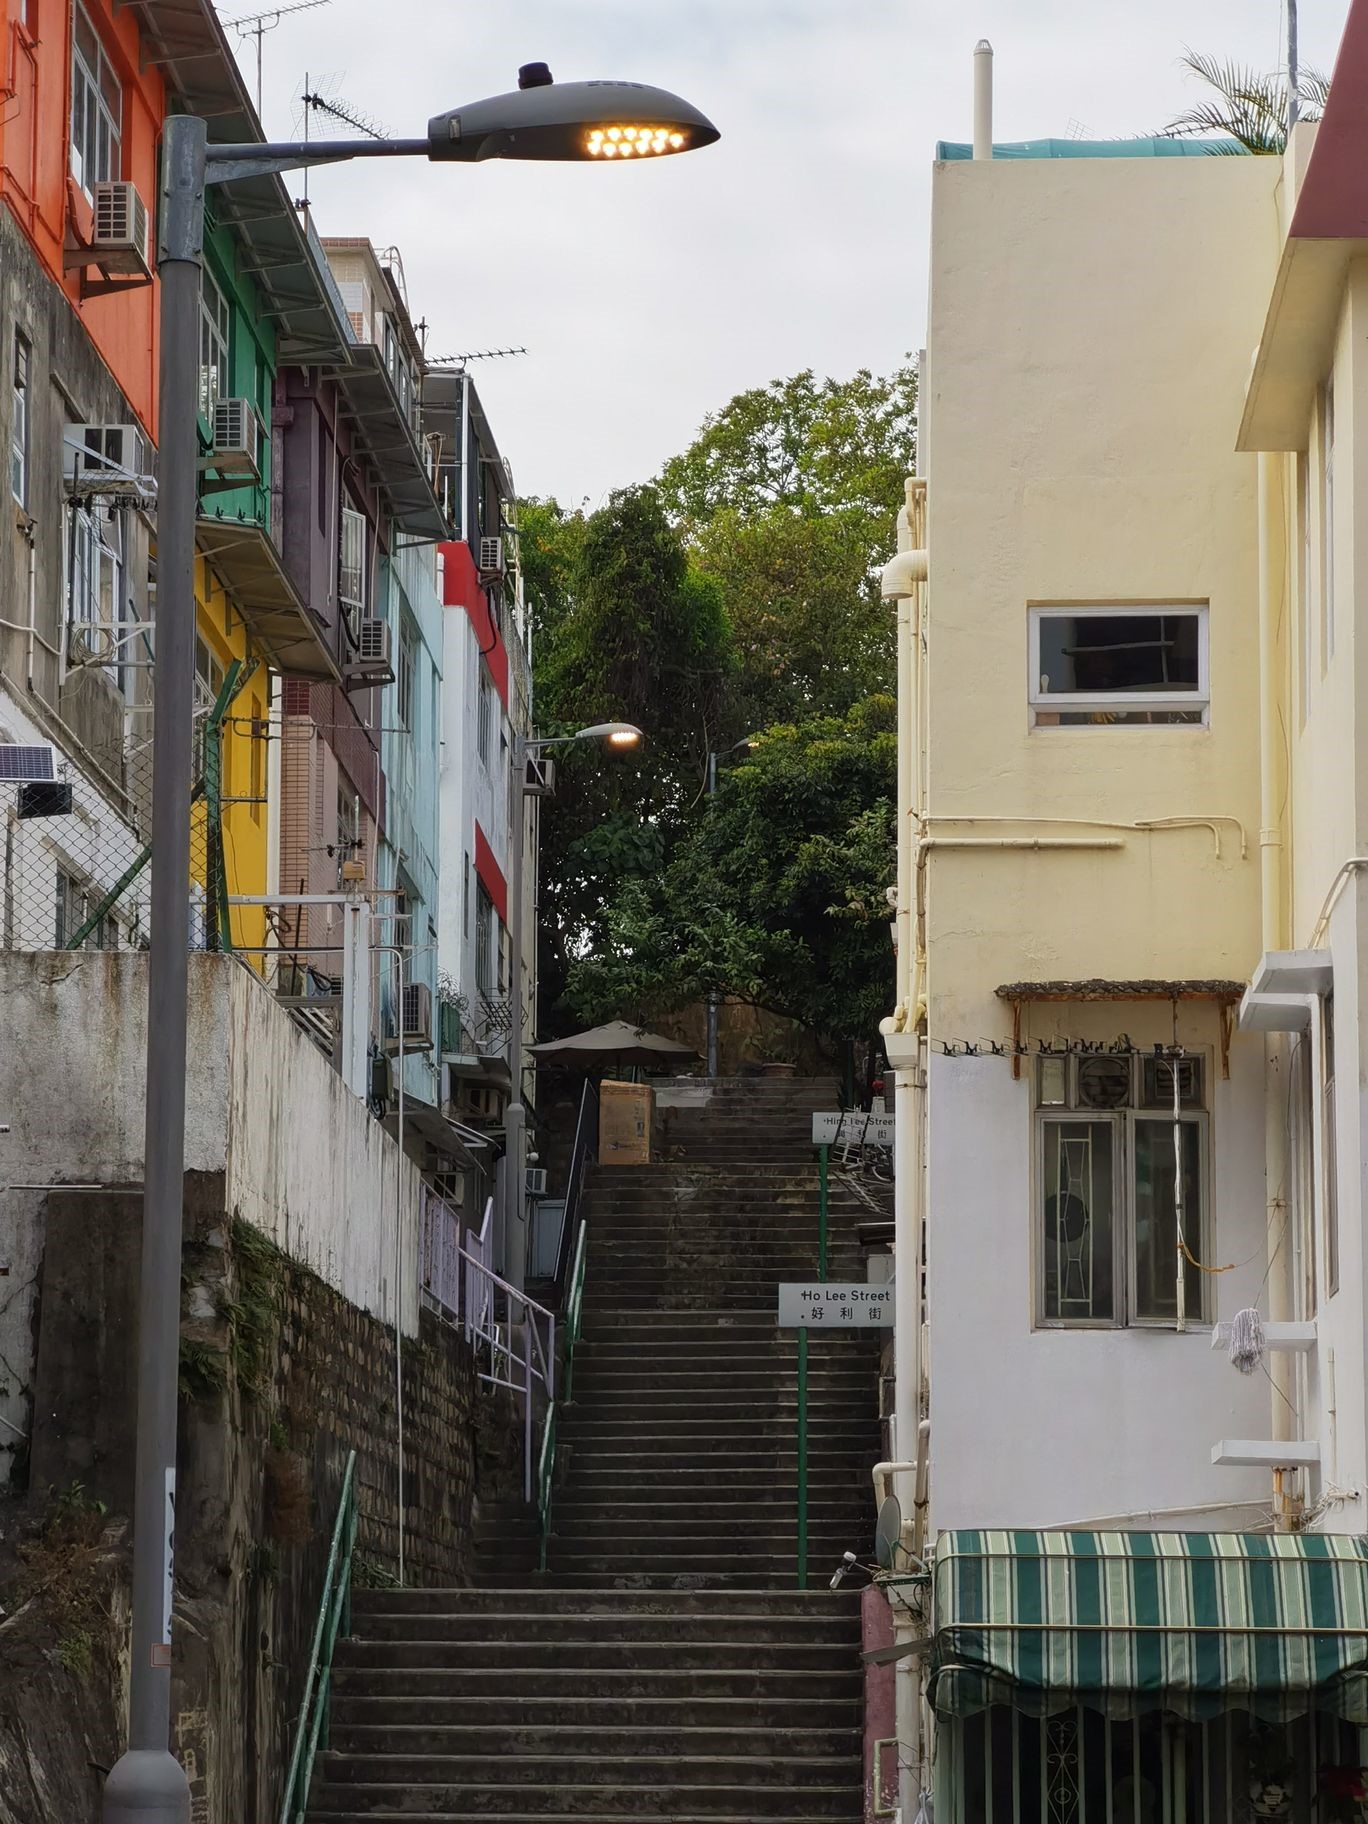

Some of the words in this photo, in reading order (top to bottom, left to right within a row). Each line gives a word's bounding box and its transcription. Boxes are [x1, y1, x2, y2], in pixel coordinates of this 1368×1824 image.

[803, 1290, 820, 1301] Ho
[826, 1290, 846, 1301] Lee
[851, 1290, 890, 1301] Street
[811, 1307, 882, 1320] 好利街
